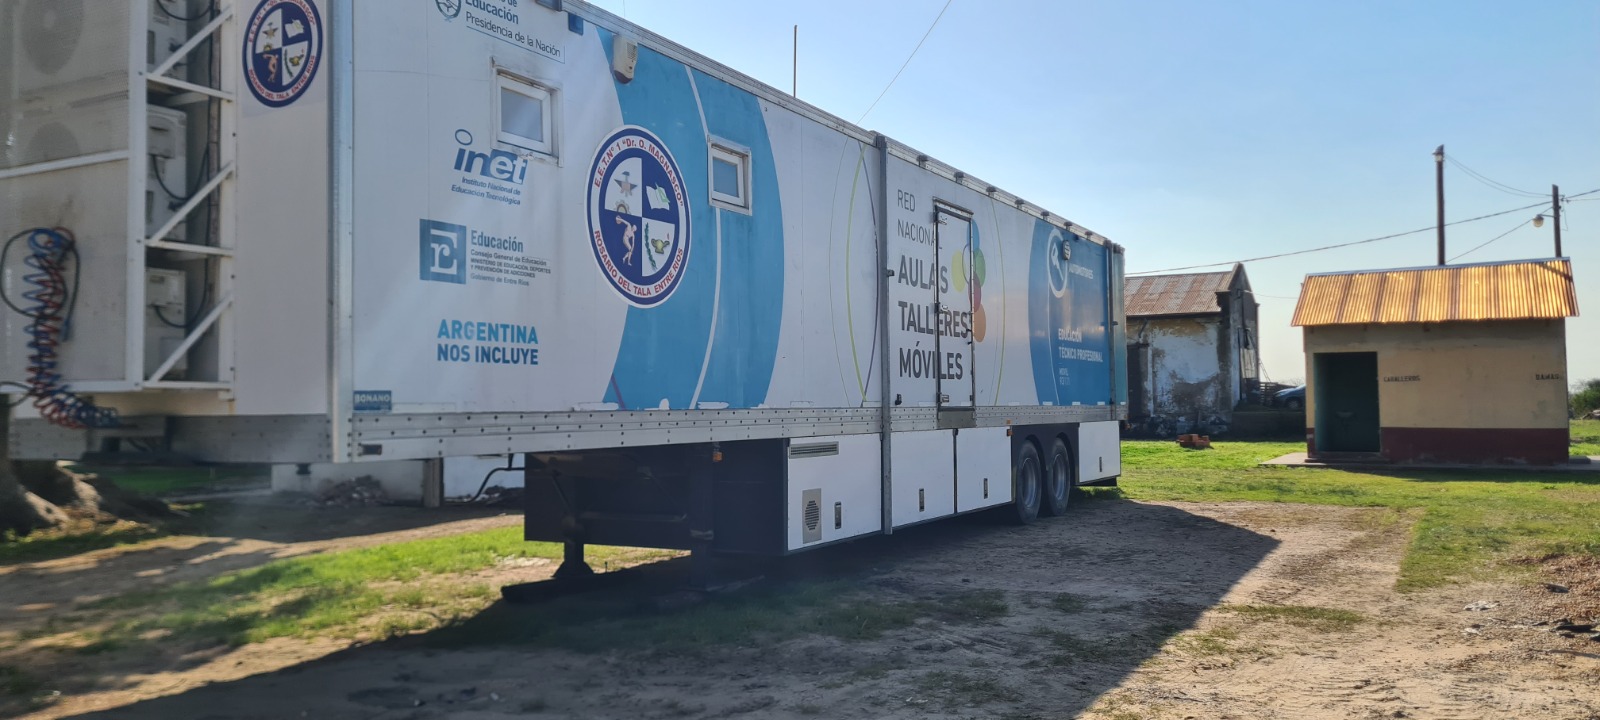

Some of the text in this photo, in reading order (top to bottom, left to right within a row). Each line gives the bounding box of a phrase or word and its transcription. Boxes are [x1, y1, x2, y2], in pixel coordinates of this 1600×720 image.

[466, 11, 560, 57] Presidencia de la Nación
[454, 129, 527, 185] inet
[462, 177, 486, 188] Instituto
[488, 182, 513, 194] Nacional
[898, 189, 915, 212] RED
[470, 230, 523, 252] Educación
[470, 249, 493, 260] Consejo
[494, 252, 513, 261] General
[594, 230, 684, 296] ROSARIO DEL TALA ENTRE RIOS
[898, 254, 948, 294] AULAS
[437, 318, 538, 344] ARGENTINA
[898, 300, 968, 338] TALLERES
[437, 344, 538, 365] NOS INCLUYE
[900, 340, 963, 380] MÓVILES
